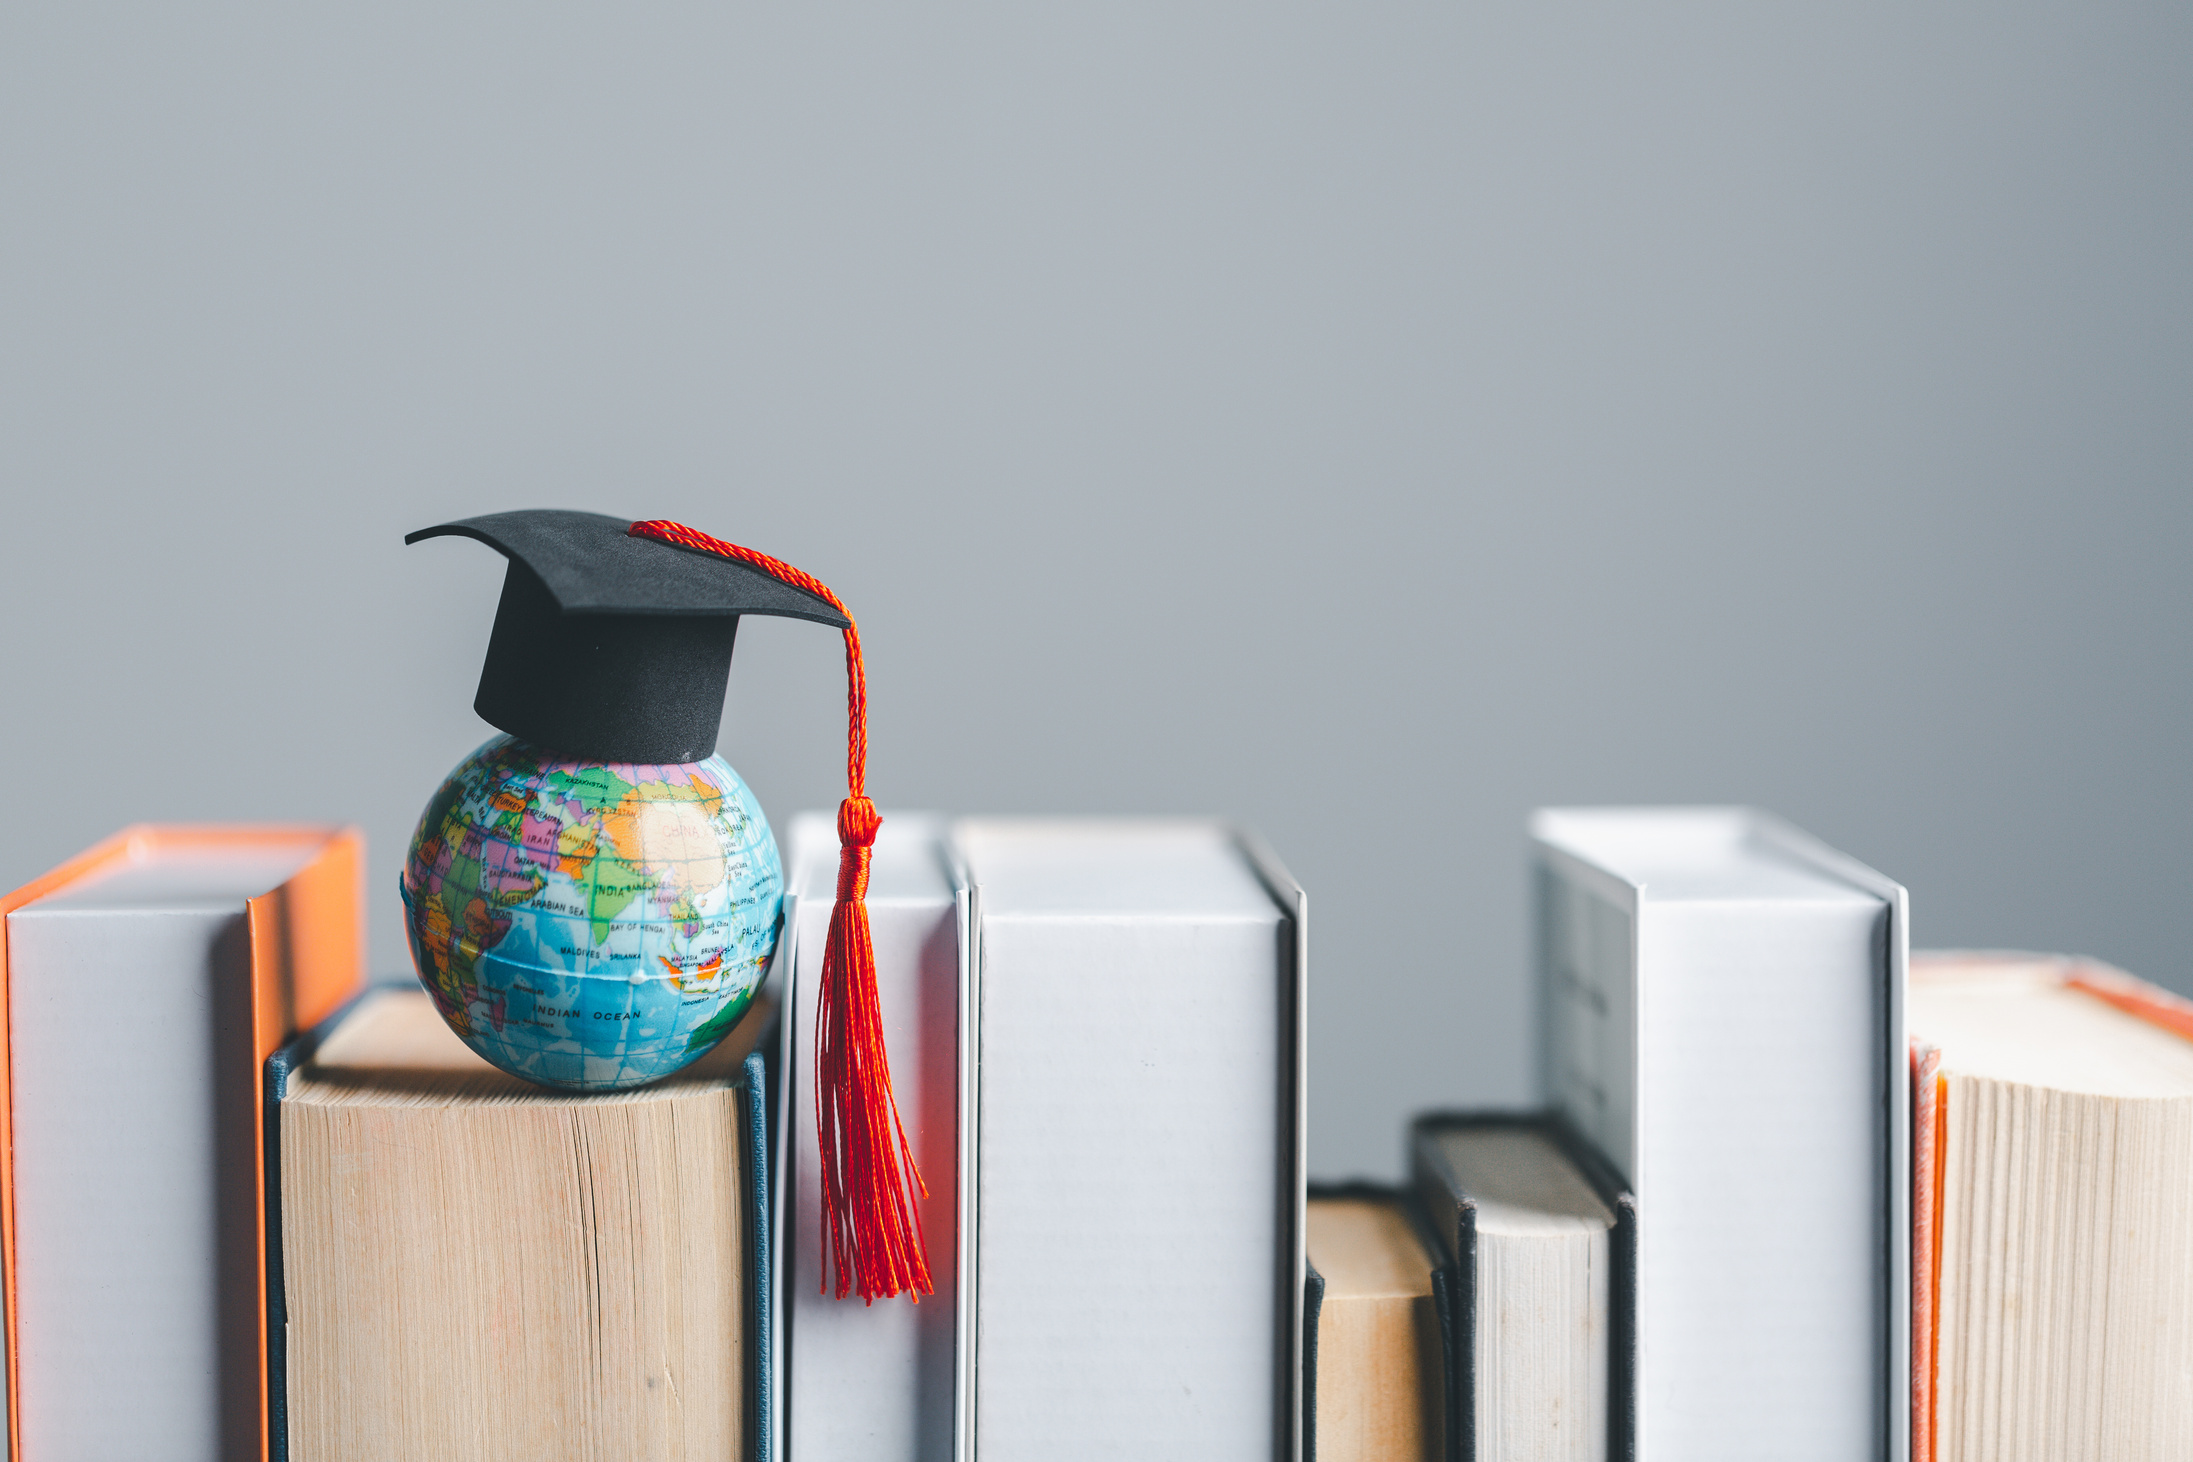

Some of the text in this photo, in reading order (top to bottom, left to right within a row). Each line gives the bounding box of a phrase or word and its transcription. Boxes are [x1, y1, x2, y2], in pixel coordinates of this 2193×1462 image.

[496, 796, 523, 812] TURKEY
[661, 825, 700, 839] CHINA
[526, 834, 551, 846] IRAN
[546, 828, 600, 854] AFGHANISTAN
[594, 884, 625, 898] INDIA
[530, 899, 585, 918] ARABIAN SEA
[668, 913, 699, 921] THAILAND
[610, 923, 625, 932] BAY
[627, 922, 637, 931] OF
[742, 924, 761, 937] PALAU
[560, 947, 600, 959] MALDIVES
[671, 955, 698, 964] MALAYSIA
[532, 1003, 642, 1021] INDIAN OCEAN
